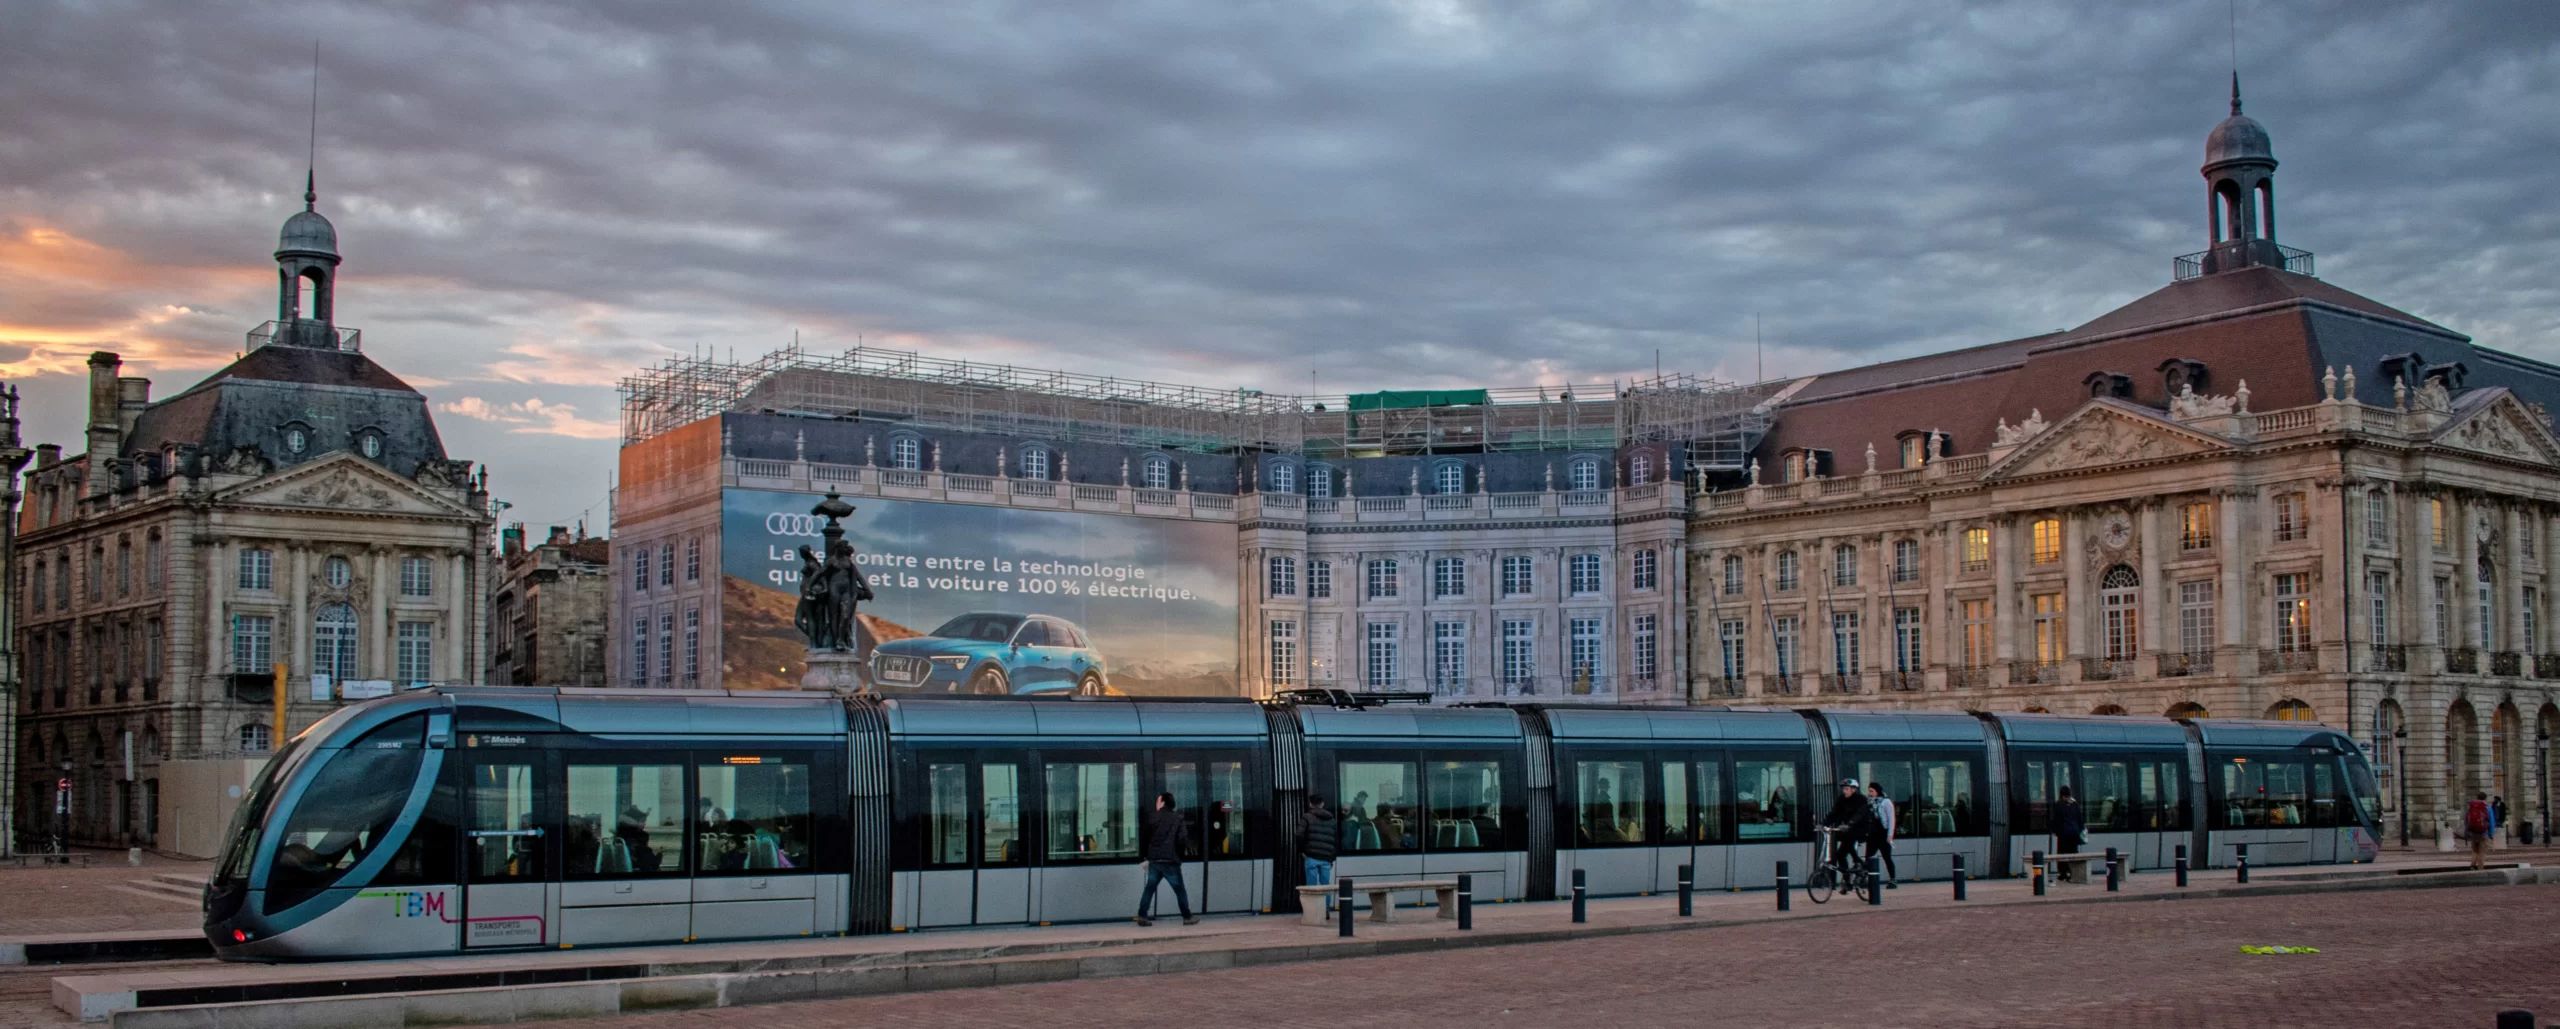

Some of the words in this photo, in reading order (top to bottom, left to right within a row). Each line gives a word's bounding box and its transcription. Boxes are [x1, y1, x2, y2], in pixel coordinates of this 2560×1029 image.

[769, 545, 795, 561] La
[803, 550, 918, 568] eontre
[925, 556, 986, 571] entre
[993, 557, 1012, 572] la
[1020, 560, 1145, 581] technologie
[867, 573, 892, 587] et
[899, 572, 919, 588] la
[926, 575, 1009, 592] voiture
[1088, 581, 1197, 602] électrique.
[386, 891, 446, 917] TBM
[474, 921, 521, 930] TRANSPORTS
